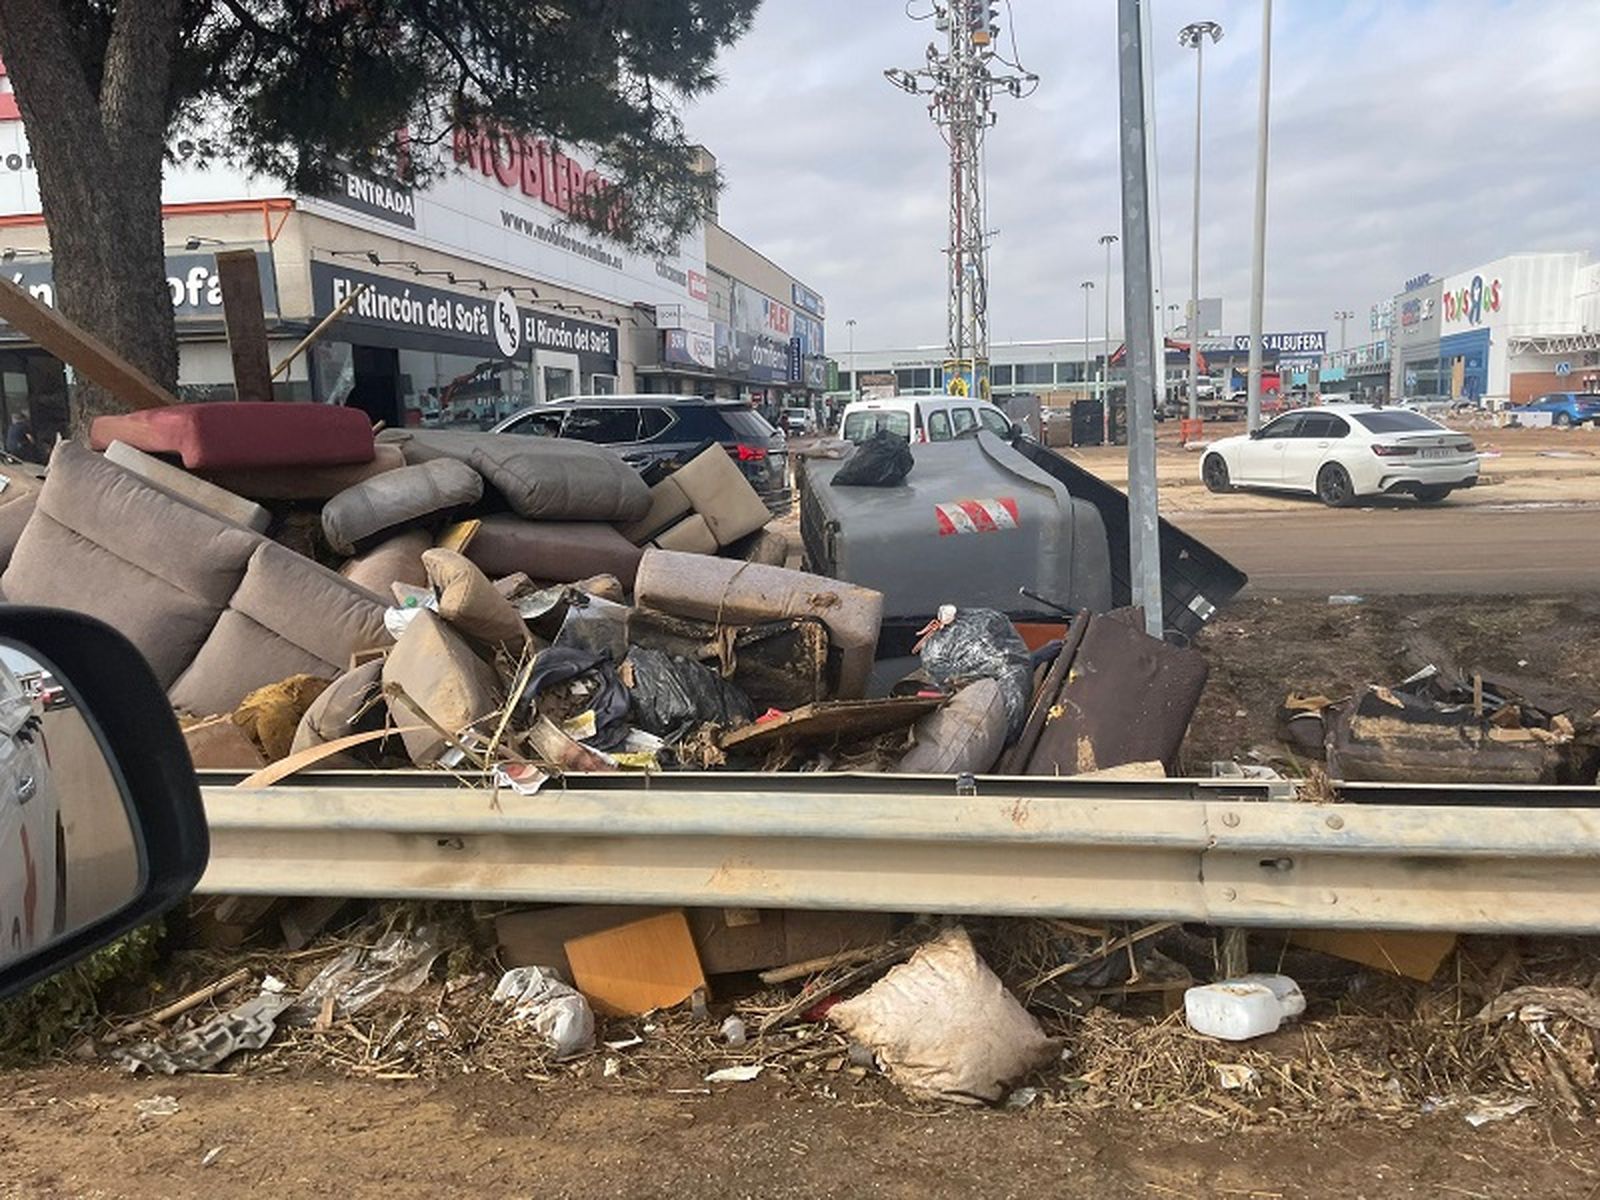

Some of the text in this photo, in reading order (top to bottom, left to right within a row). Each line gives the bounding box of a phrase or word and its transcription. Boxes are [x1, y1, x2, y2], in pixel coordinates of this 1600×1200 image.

[346, 173, 415, 218] ENTRADA
[333, 278, 489, 335] El Rincón del Sofá
[525, 317, 610, 354] El Rincón del Sofá
